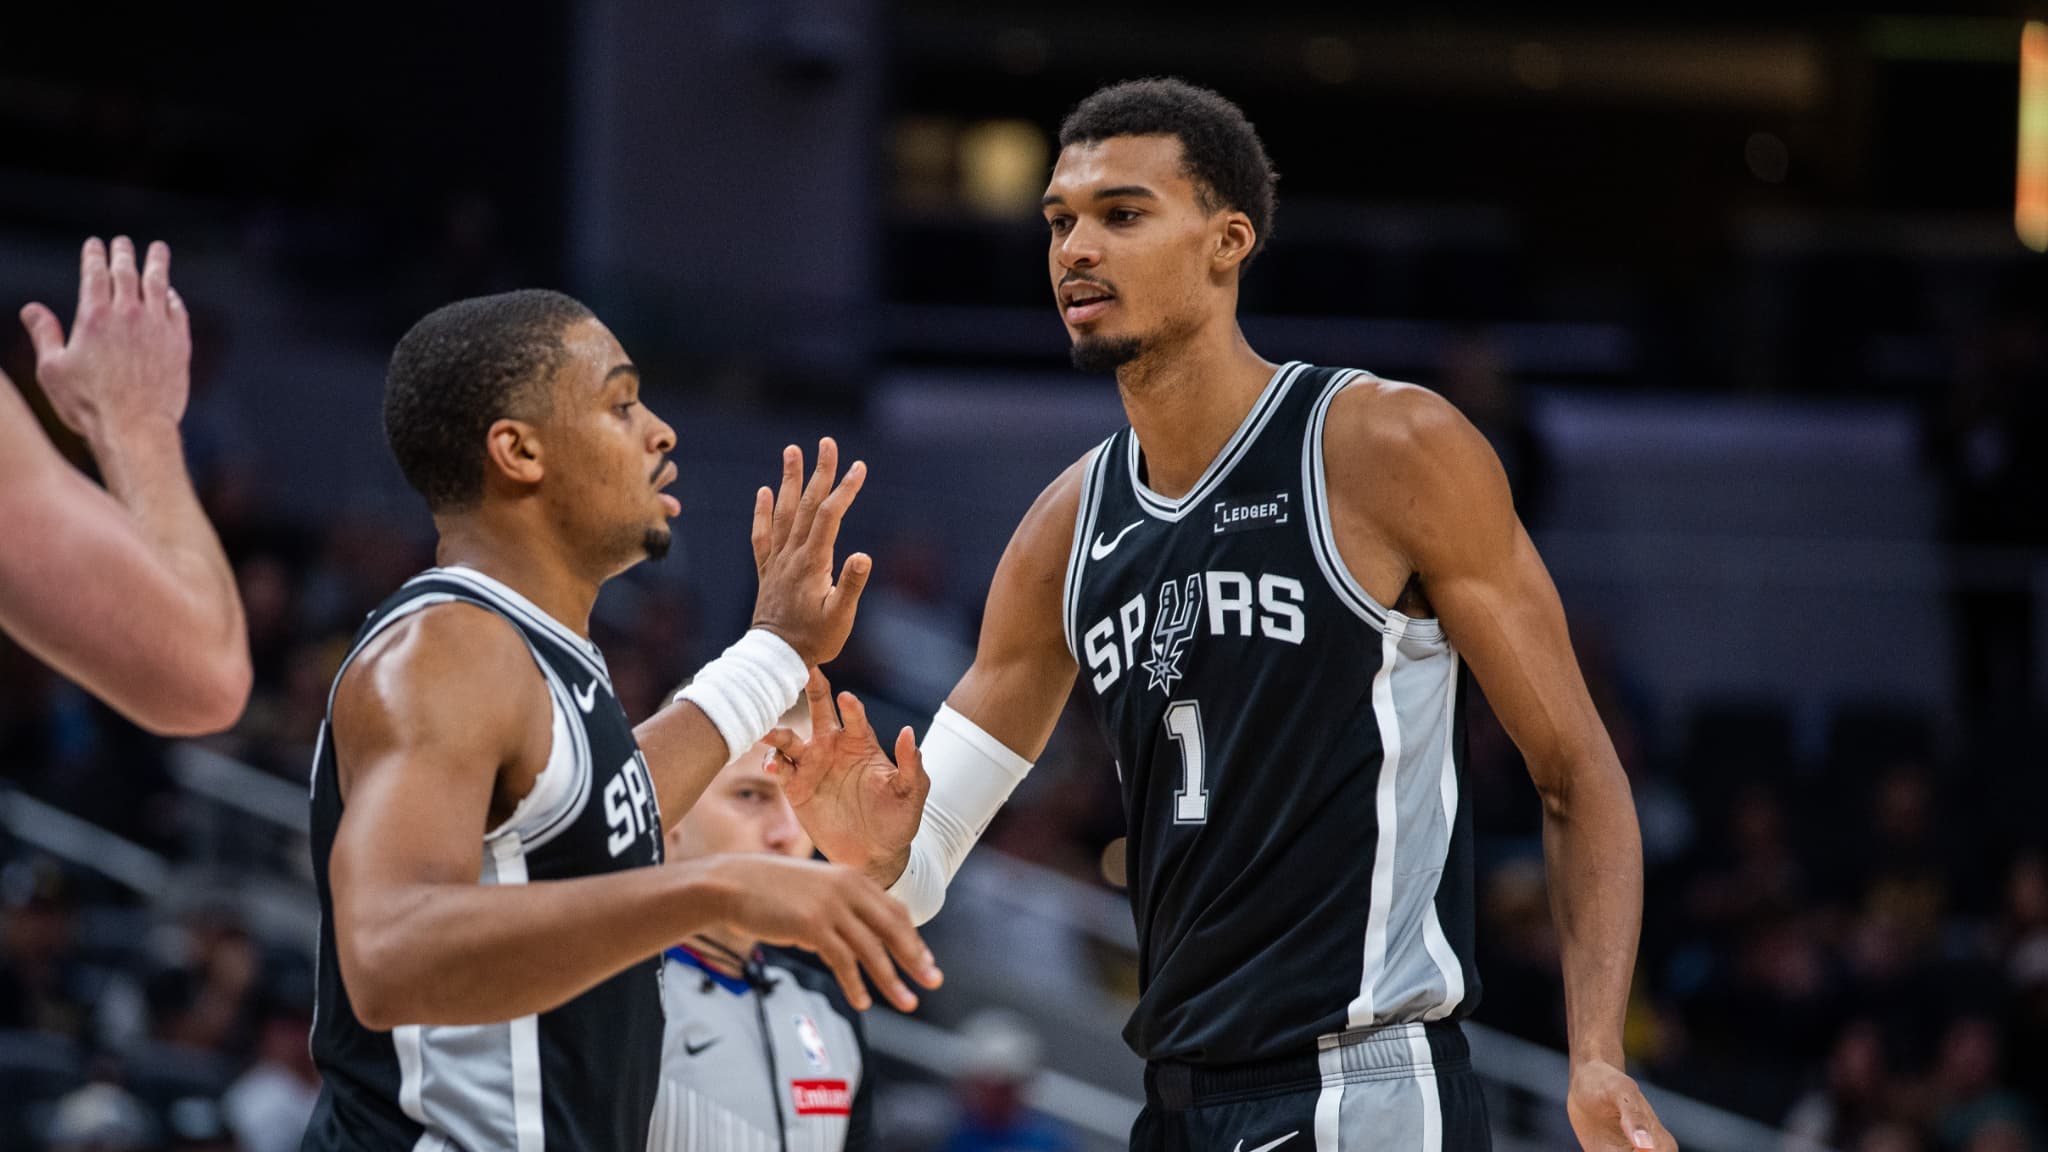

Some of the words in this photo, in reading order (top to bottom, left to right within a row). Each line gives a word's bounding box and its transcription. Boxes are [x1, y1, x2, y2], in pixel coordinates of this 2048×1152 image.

[1223, 502, 1278, 523] LEDGER
[1084, 570, 1305, 697] SPURS
[1163, 699, 1209, 825] 1
